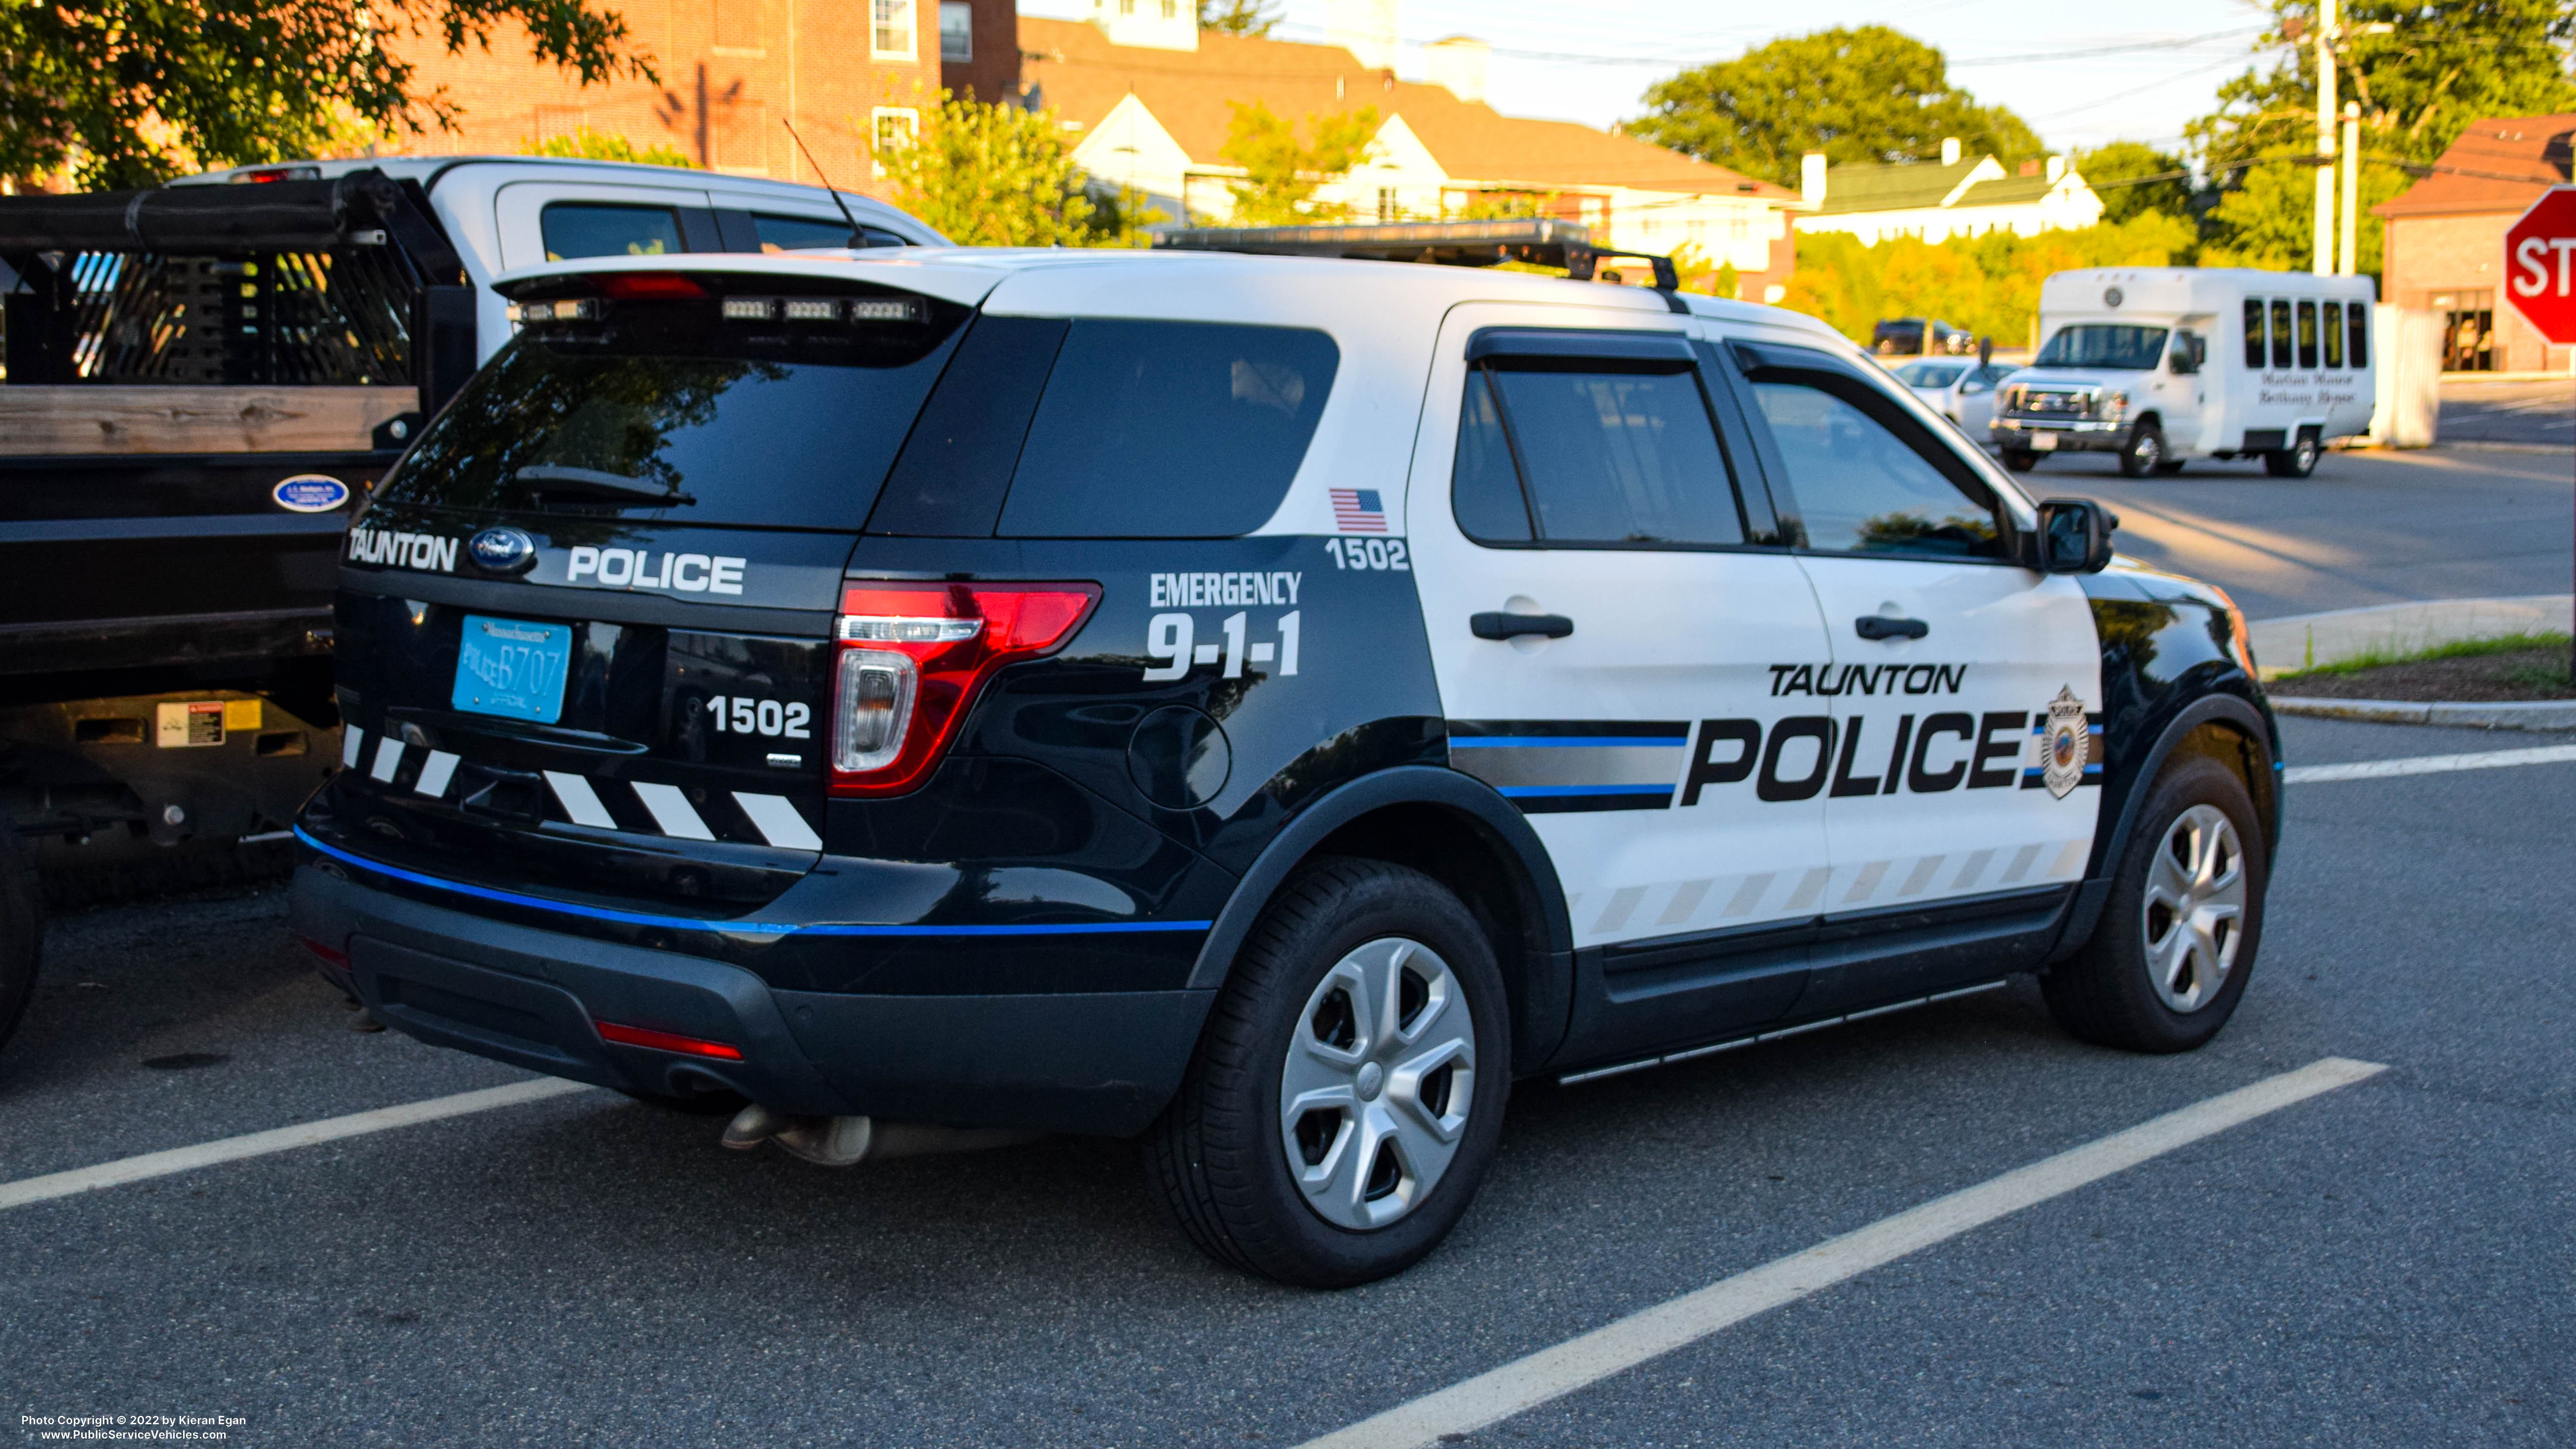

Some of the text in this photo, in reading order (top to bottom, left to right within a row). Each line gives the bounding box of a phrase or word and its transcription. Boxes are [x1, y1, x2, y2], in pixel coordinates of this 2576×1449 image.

[349, 527, 747, 595] TAUNTON POLICE
[477, 532, 515, 558] Ford
[1325, 537, 1410, 571] 1502
[1150, 571, 1302, 608] EMERGENCY
[1142, 610, 1300, 681] 9-1-1
[497, 645, 561, 696] B707
[1767, 663, 1968, 697] TAUNTON
[706, 695, 811, 739] 1502
[1679, 710, 2029, 808] POLICE
